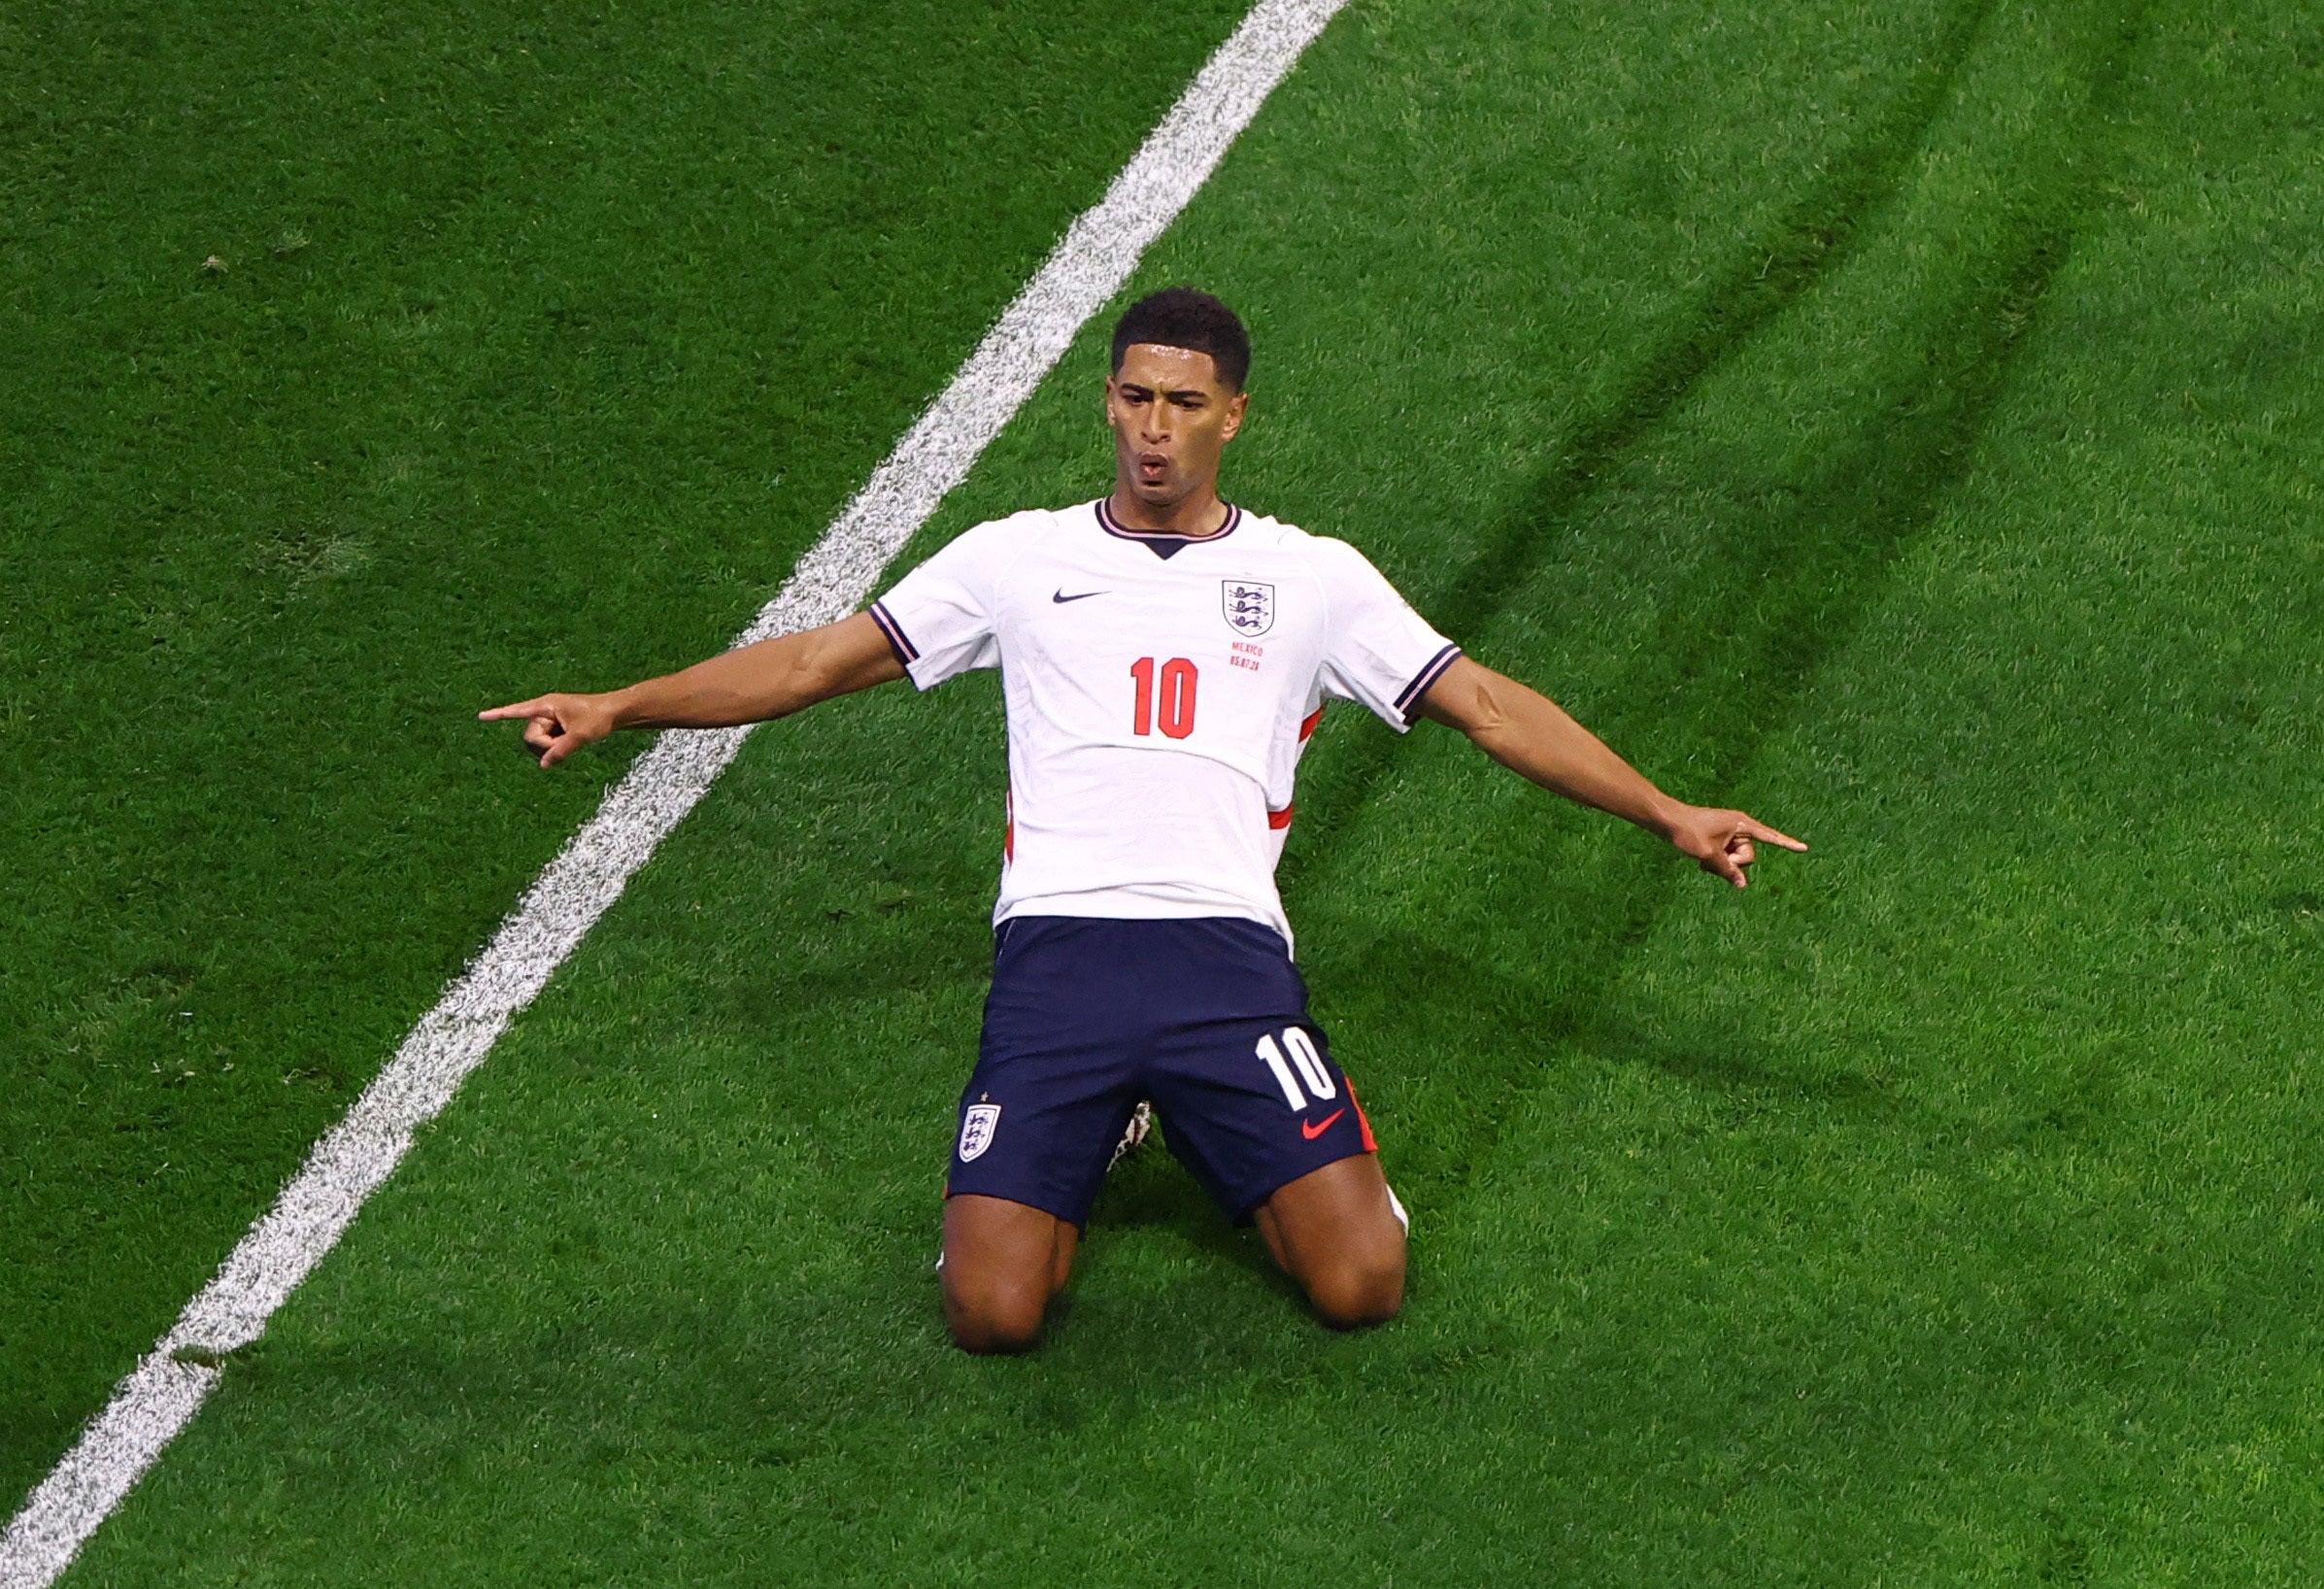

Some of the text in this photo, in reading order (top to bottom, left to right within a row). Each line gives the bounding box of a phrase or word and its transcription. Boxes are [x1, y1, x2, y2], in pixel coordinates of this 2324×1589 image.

[1231, 641, 1263, 657] MEXICO
[1131, 657, 1198, 739] 10
[1256, 1027, 1336, 1112] 10
